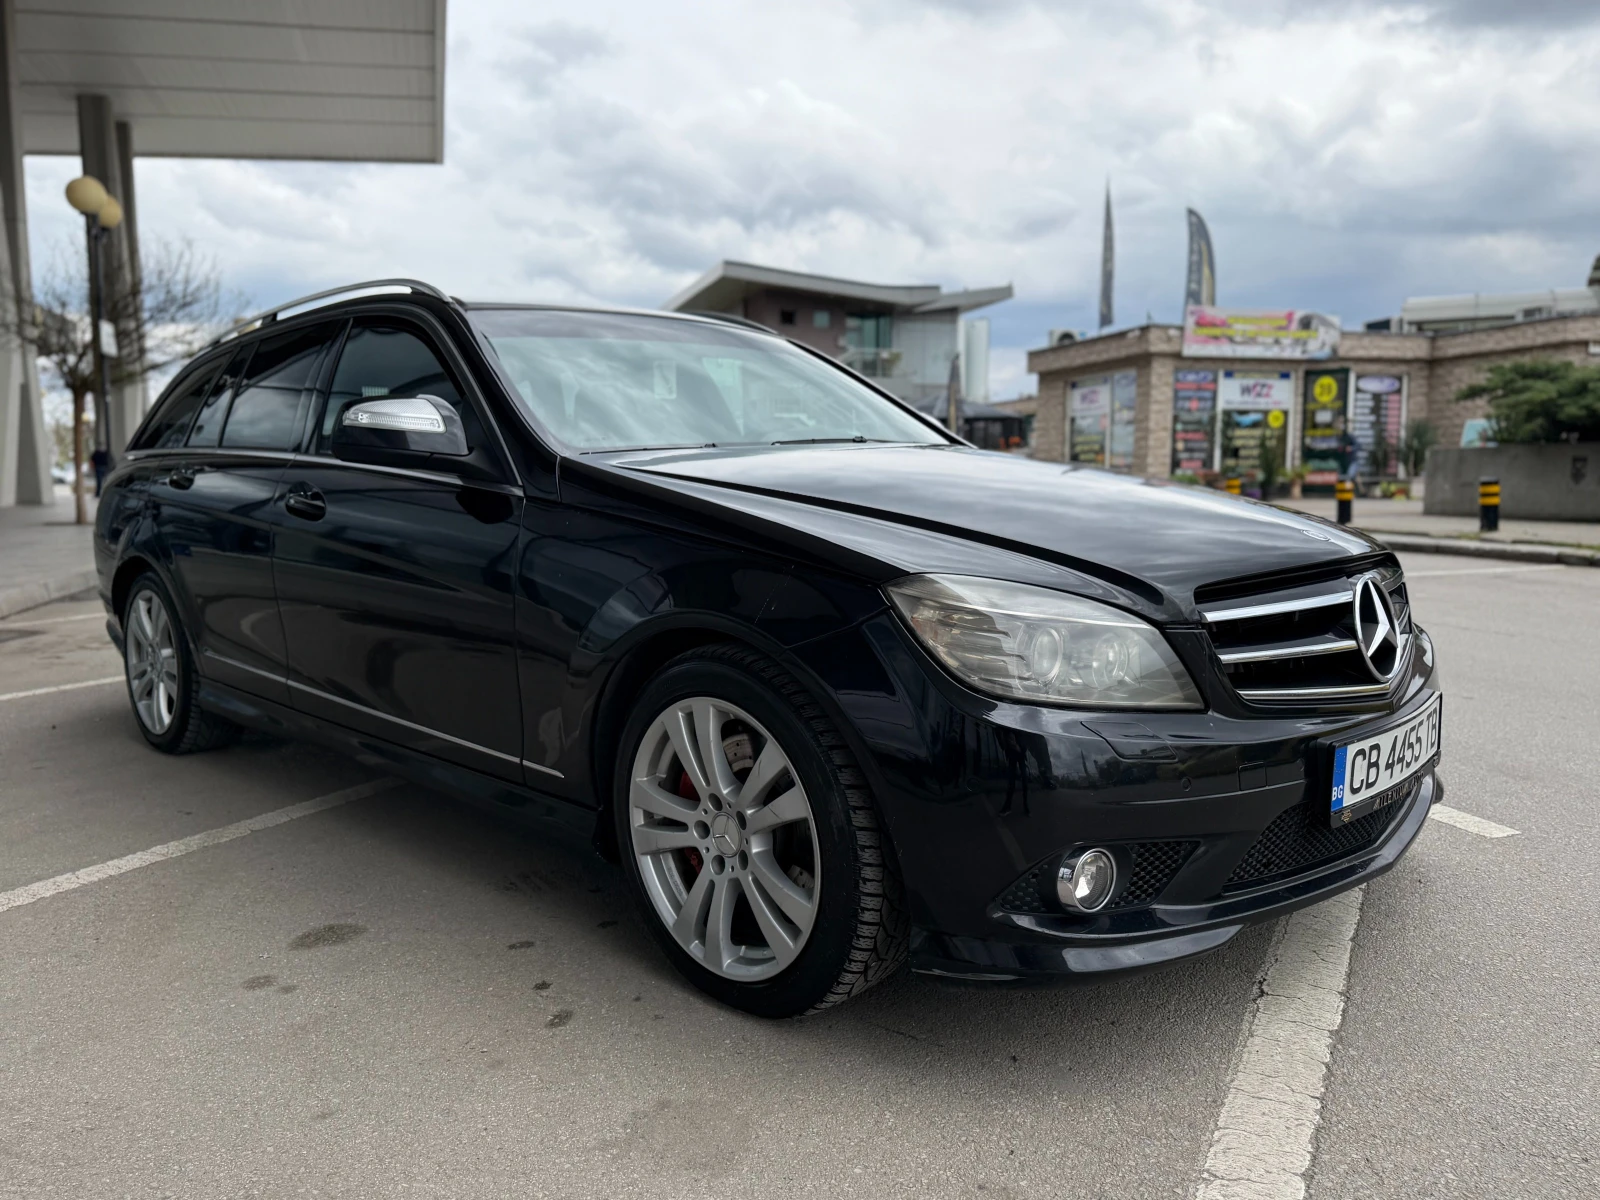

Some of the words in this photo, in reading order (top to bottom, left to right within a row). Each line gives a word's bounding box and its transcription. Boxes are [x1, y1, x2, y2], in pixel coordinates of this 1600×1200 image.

[1349, 743, 1381, 795] CB
[1385, 720, 1424, 780] 4455
[1425, 706, 1438, 755] TB
[1331, 784, 1344, 801] BG
